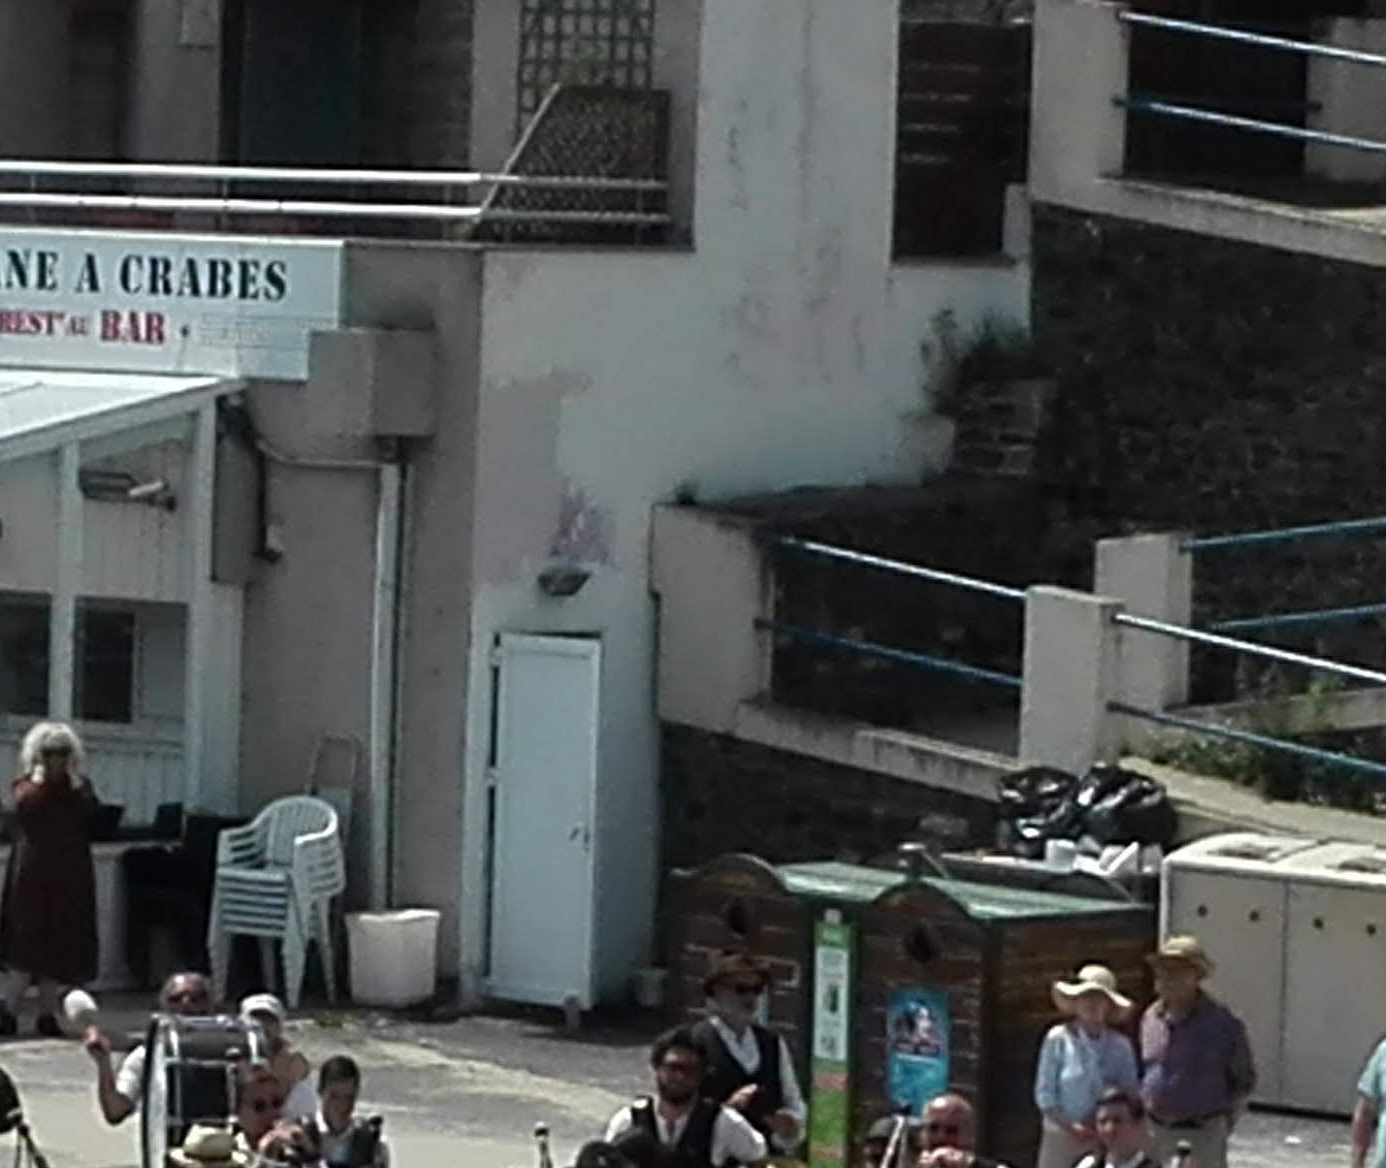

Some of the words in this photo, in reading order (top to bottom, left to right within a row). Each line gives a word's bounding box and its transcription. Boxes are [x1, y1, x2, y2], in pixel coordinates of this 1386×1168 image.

[75, 252, 101, 293] A
[120, 254, 287, 301] CRABES
[100, 309, 165, 344] BAR
